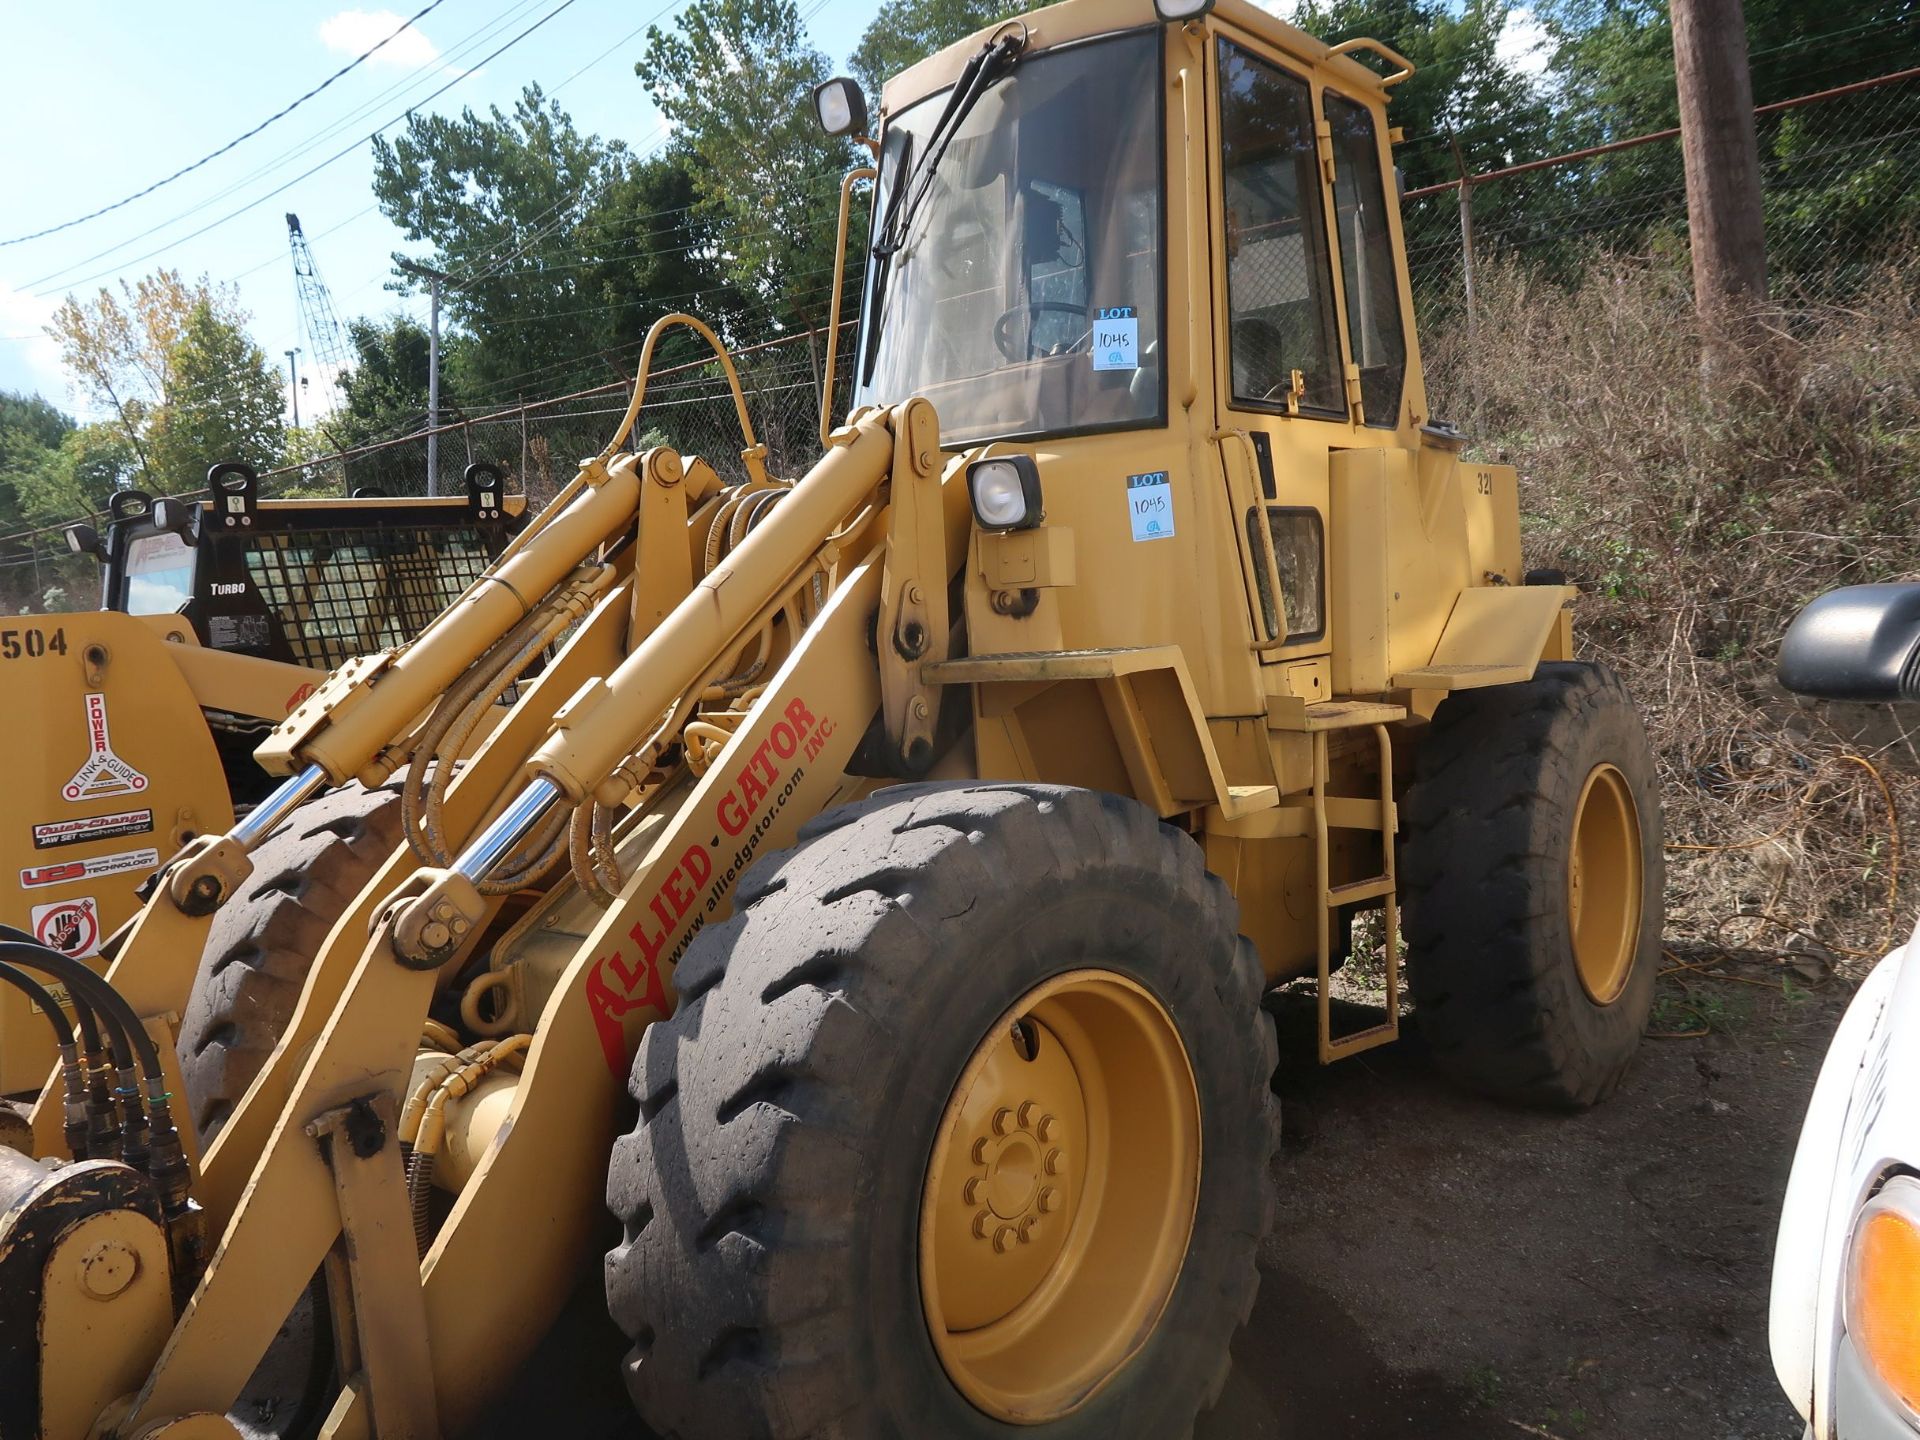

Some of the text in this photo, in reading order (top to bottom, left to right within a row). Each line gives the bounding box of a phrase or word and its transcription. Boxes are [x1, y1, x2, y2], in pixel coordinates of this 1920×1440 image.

[1100, 307, 1132, 320] LOT
[1099, 333, 1130, 348] 1045
[1132, 472, 1164, 488] LOT
[1477, 471, 1493, 495] 321
[1134, 495, 1166, 515] 1045
[0, 627, 68, 659] 504
[90, 697, 106, 752] POWER
[73, 755, 136, 788] LINK & GUIDE
[39, 835, 60, 845] JAW
[60, 832, 78, 842] SET
[79, 823, 149, 839] technology
[87, 857, 155, 875] TECHNOLOGY
[585, 696, 838, 1080] ALLIED GATOR INC.
